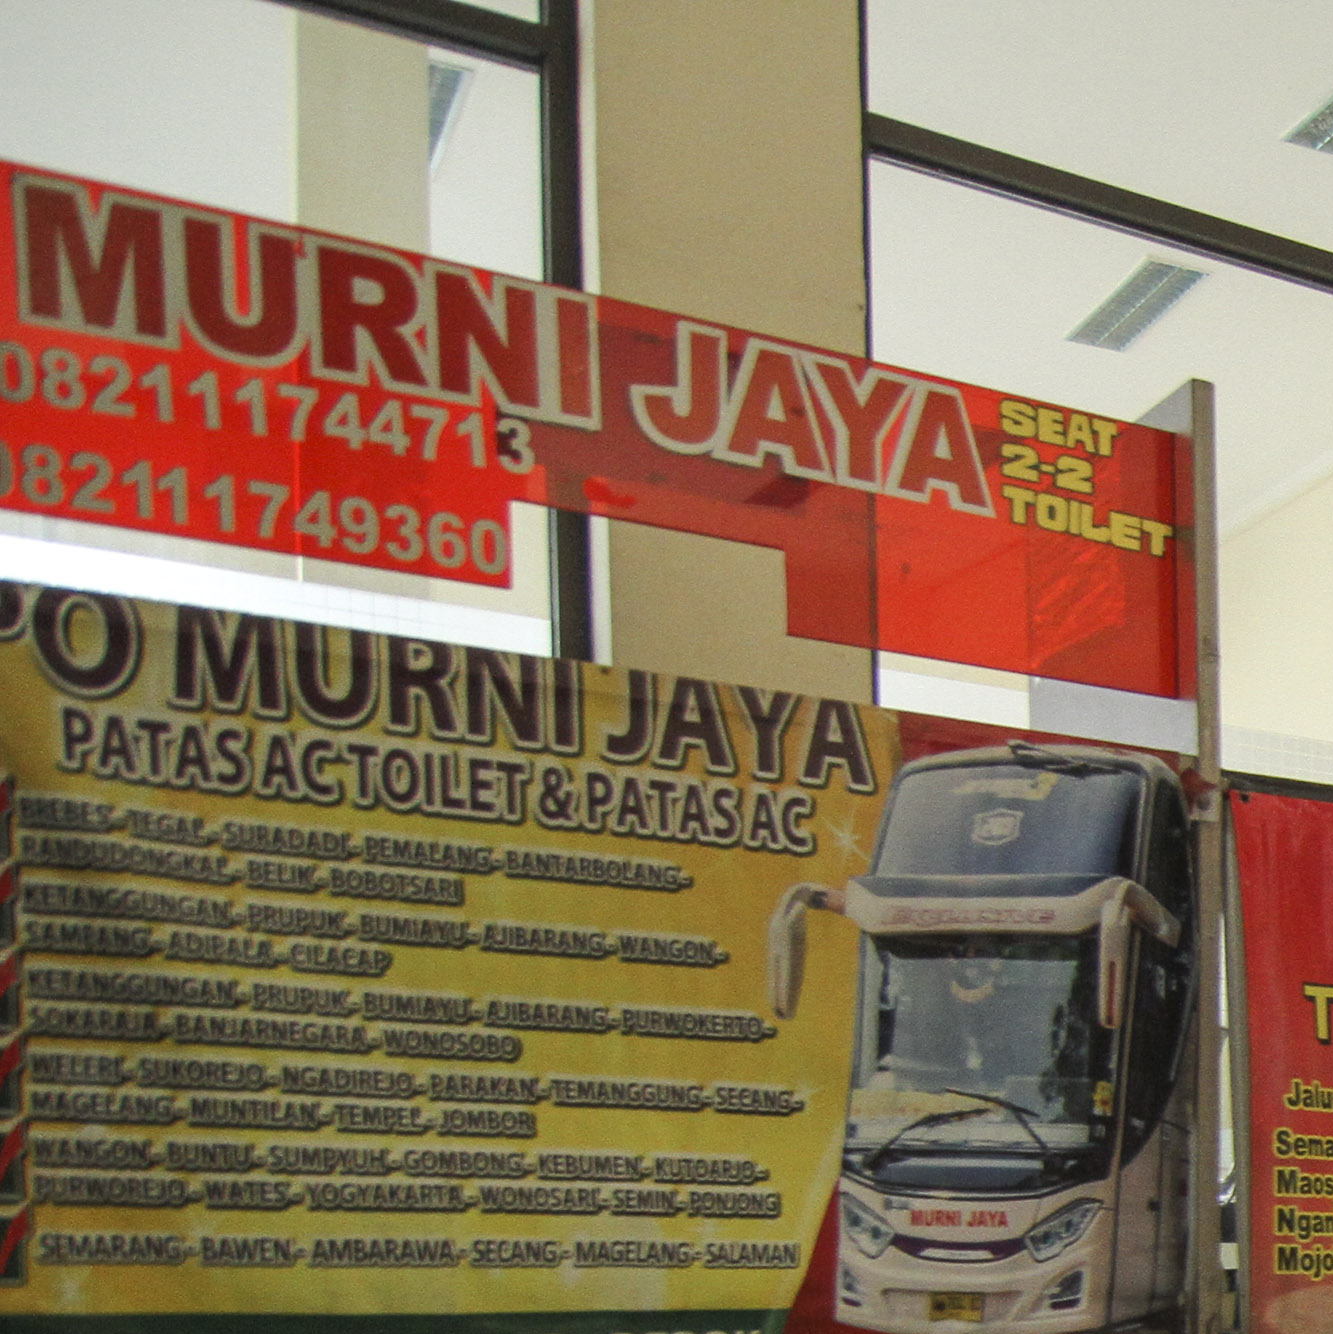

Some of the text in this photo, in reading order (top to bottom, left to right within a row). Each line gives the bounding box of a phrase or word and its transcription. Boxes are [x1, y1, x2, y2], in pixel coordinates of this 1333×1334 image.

[12, 172, 996, 518] MURNI JAYA
[1000, 399, 1119, 457] SEAT
[1001, 443, 1094, 495] 2-2
[1003, 484, 1173, 557] TOILET
[169, 604, 582, 754] MURNI
[602, 667, 876, 793] JAYA
[60, 704, 816, 856] PATAS AC TOILET & PATAS AC
[911, 1209, 1008, 1228] MURNI JAYA
